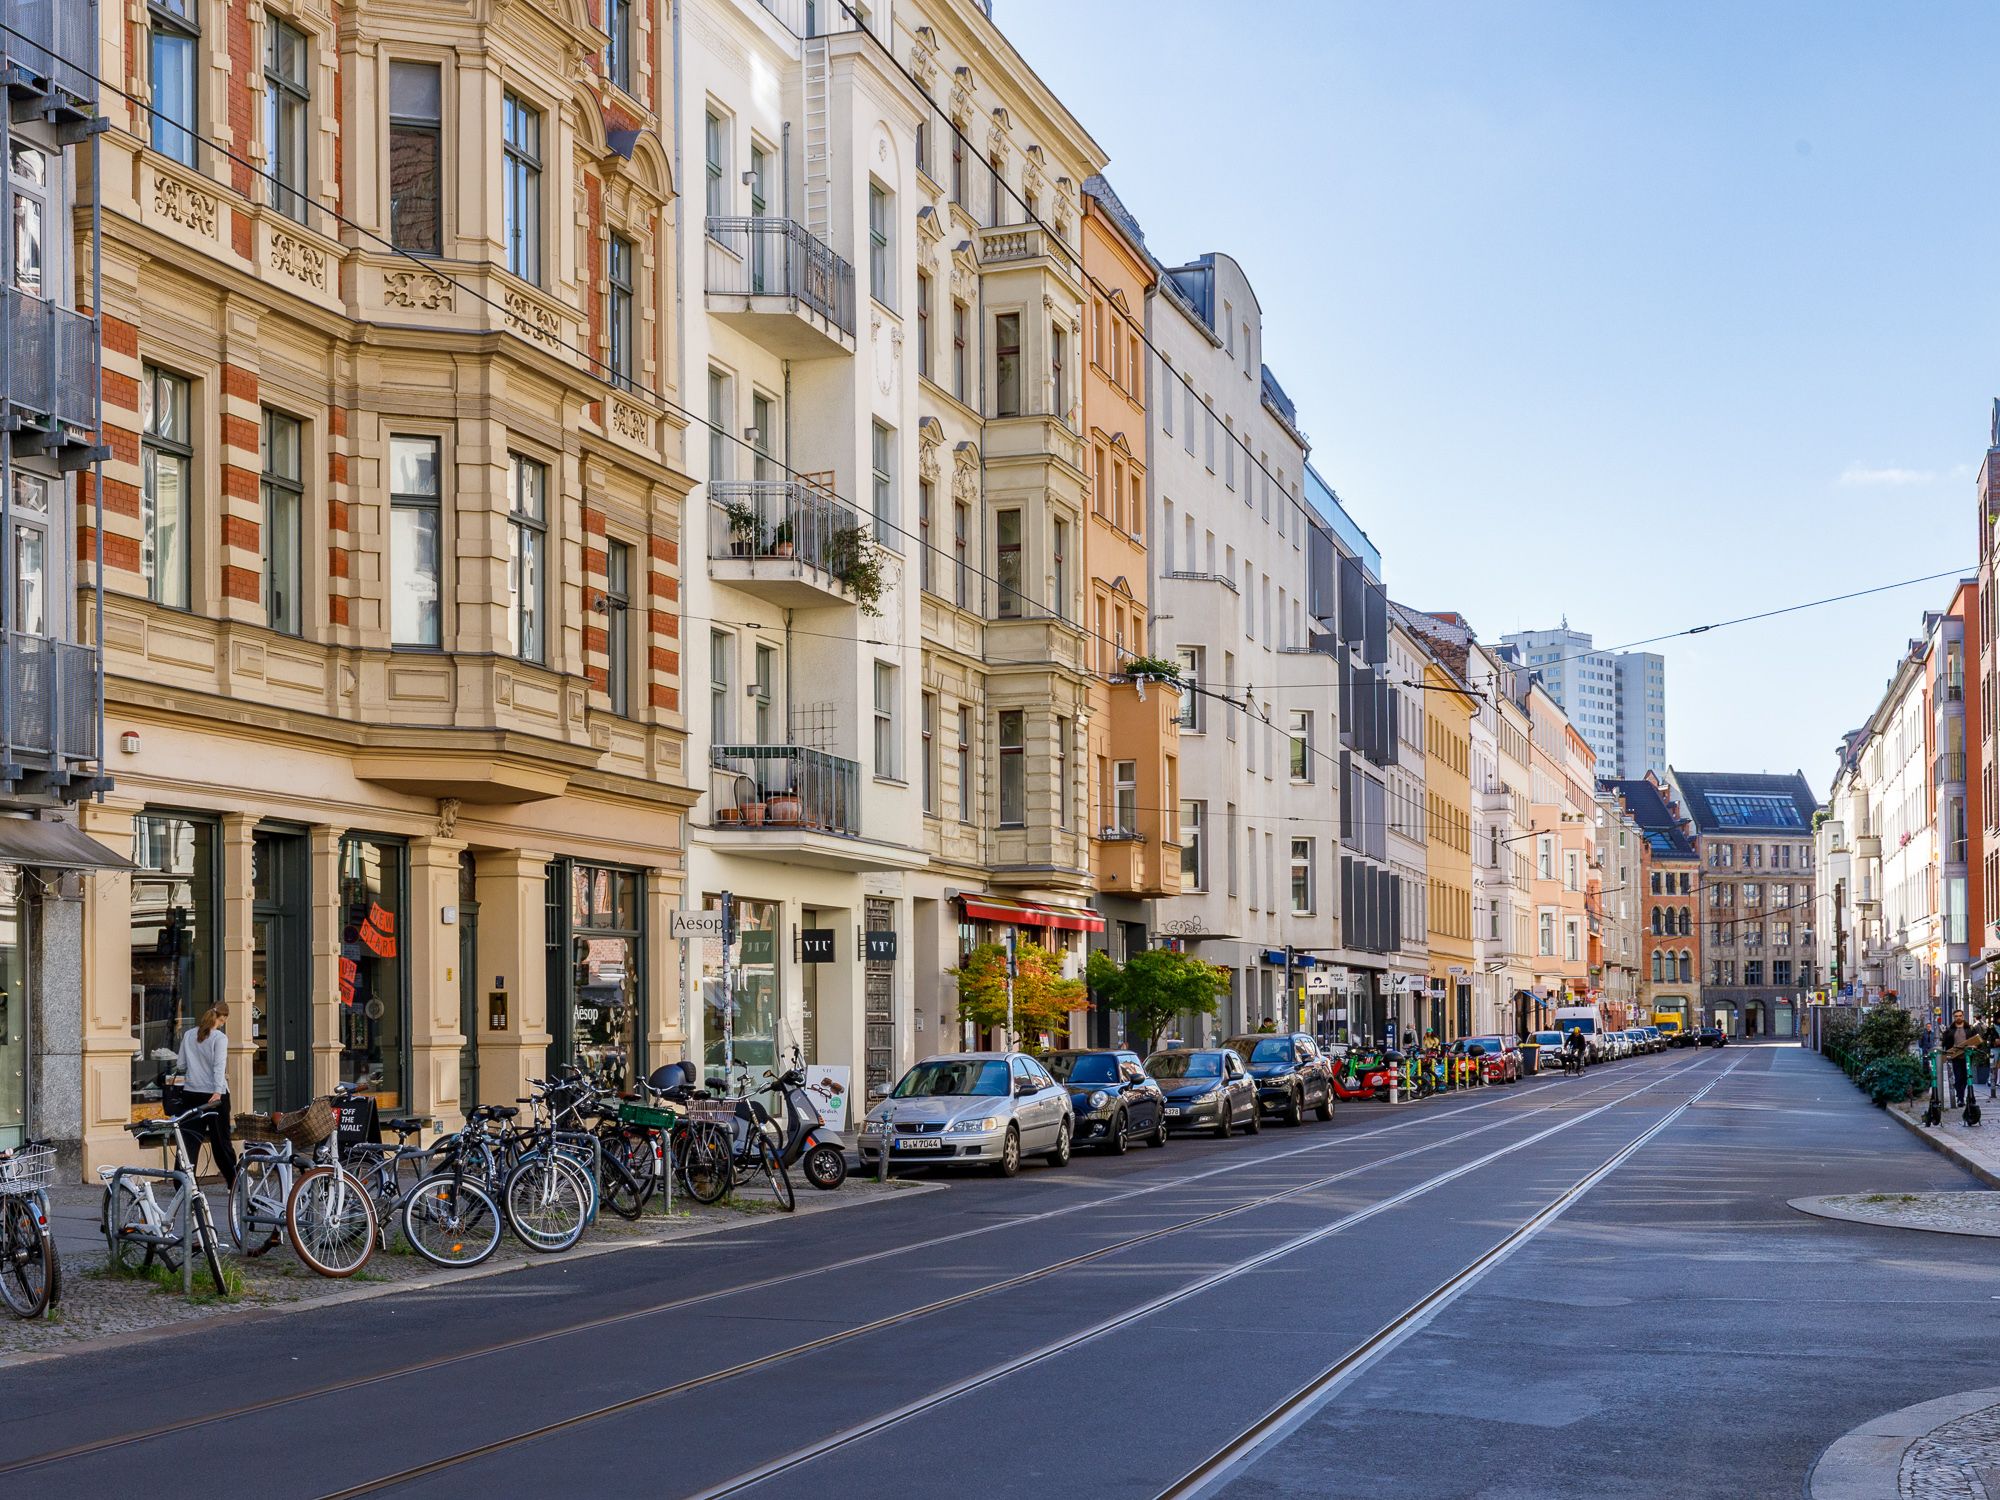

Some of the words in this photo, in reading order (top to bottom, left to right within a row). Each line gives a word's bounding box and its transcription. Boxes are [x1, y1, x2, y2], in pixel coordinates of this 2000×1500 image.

[371, 906, 394, 931] NEW
[362, 924, 396, 955] START
[804, 940, 831, 952] VIU
[902, 1140, 908, 1149] B
